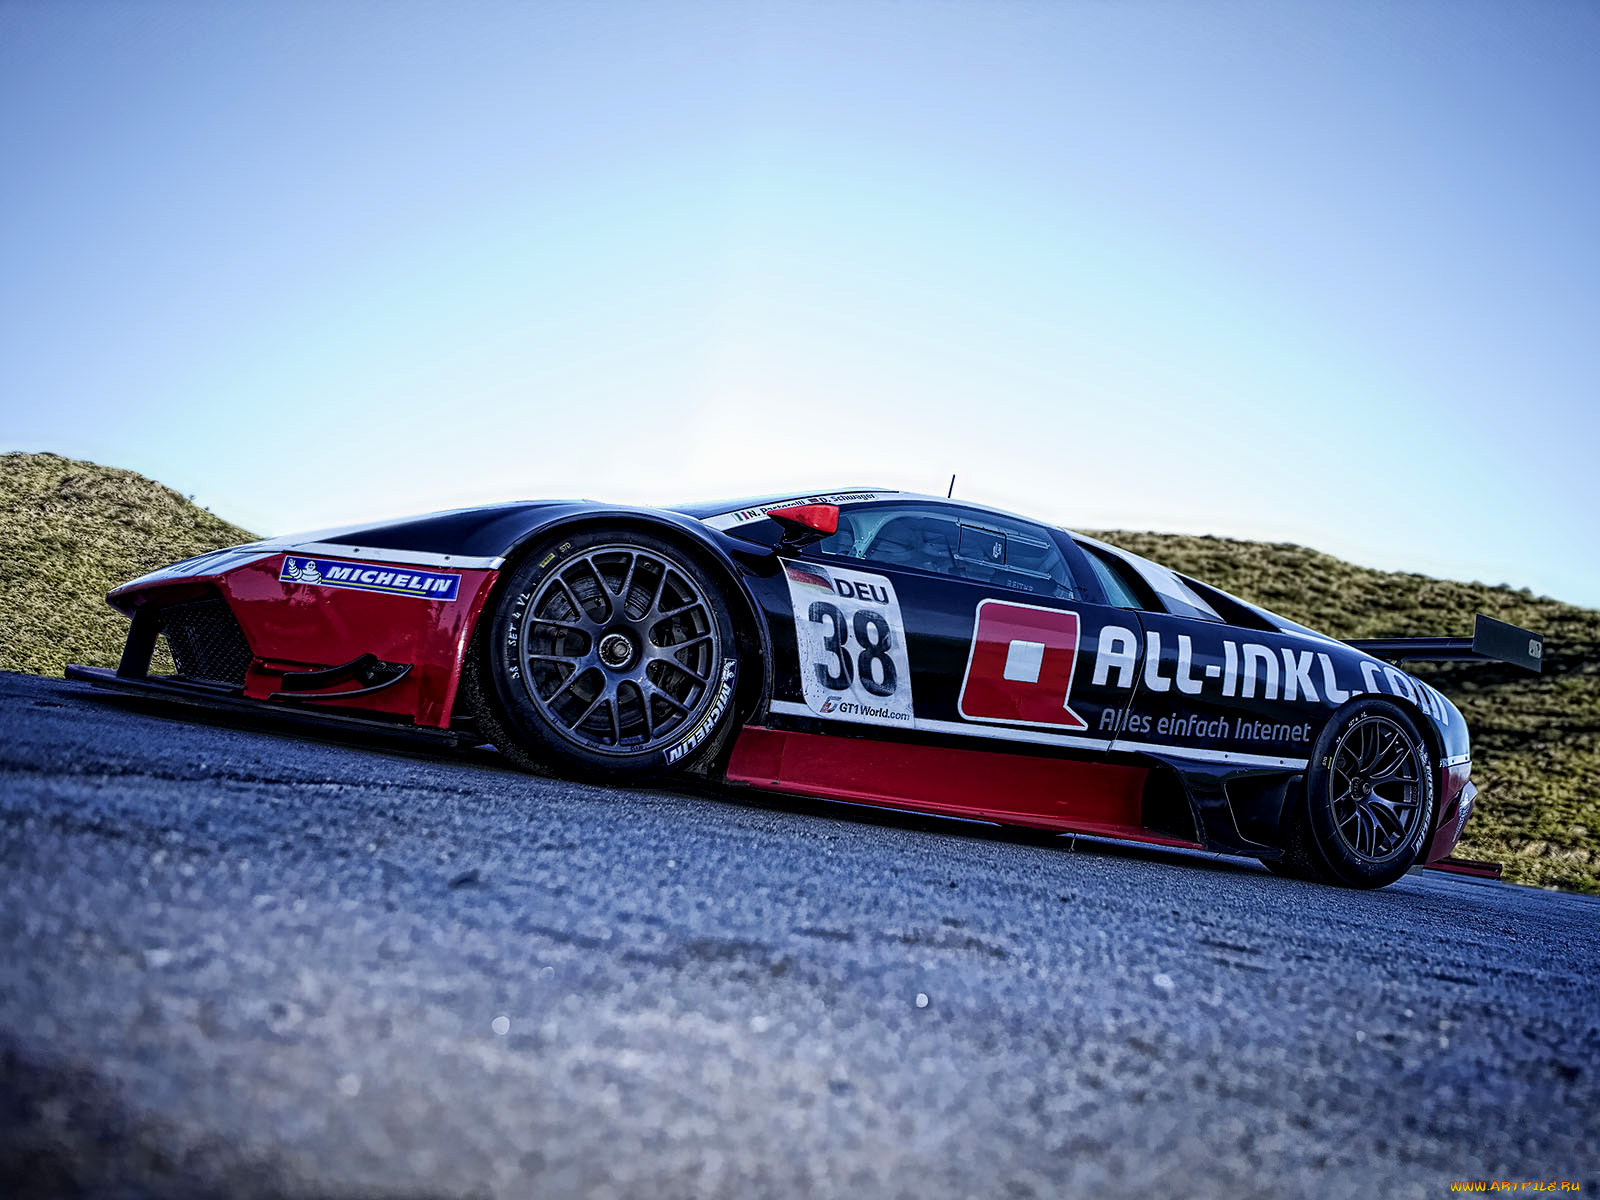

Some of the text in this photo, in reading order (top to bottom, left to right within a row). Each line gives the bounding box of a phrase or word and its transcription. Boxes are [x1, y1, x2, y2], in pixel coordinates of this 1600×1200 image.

[326, 565, 453, 593] MICHELIN
[834, 578, 890, 605] DEU
[508, 623, 518, 646] SET
[808, 601, 898, 697] 38
[669, 682, 732, 763] MICHELIN
[1099, 708, 1152, 733] Alles
[1157, 713, 1228, 738] einfach
[1235, 718, 1312, 742] Internet
